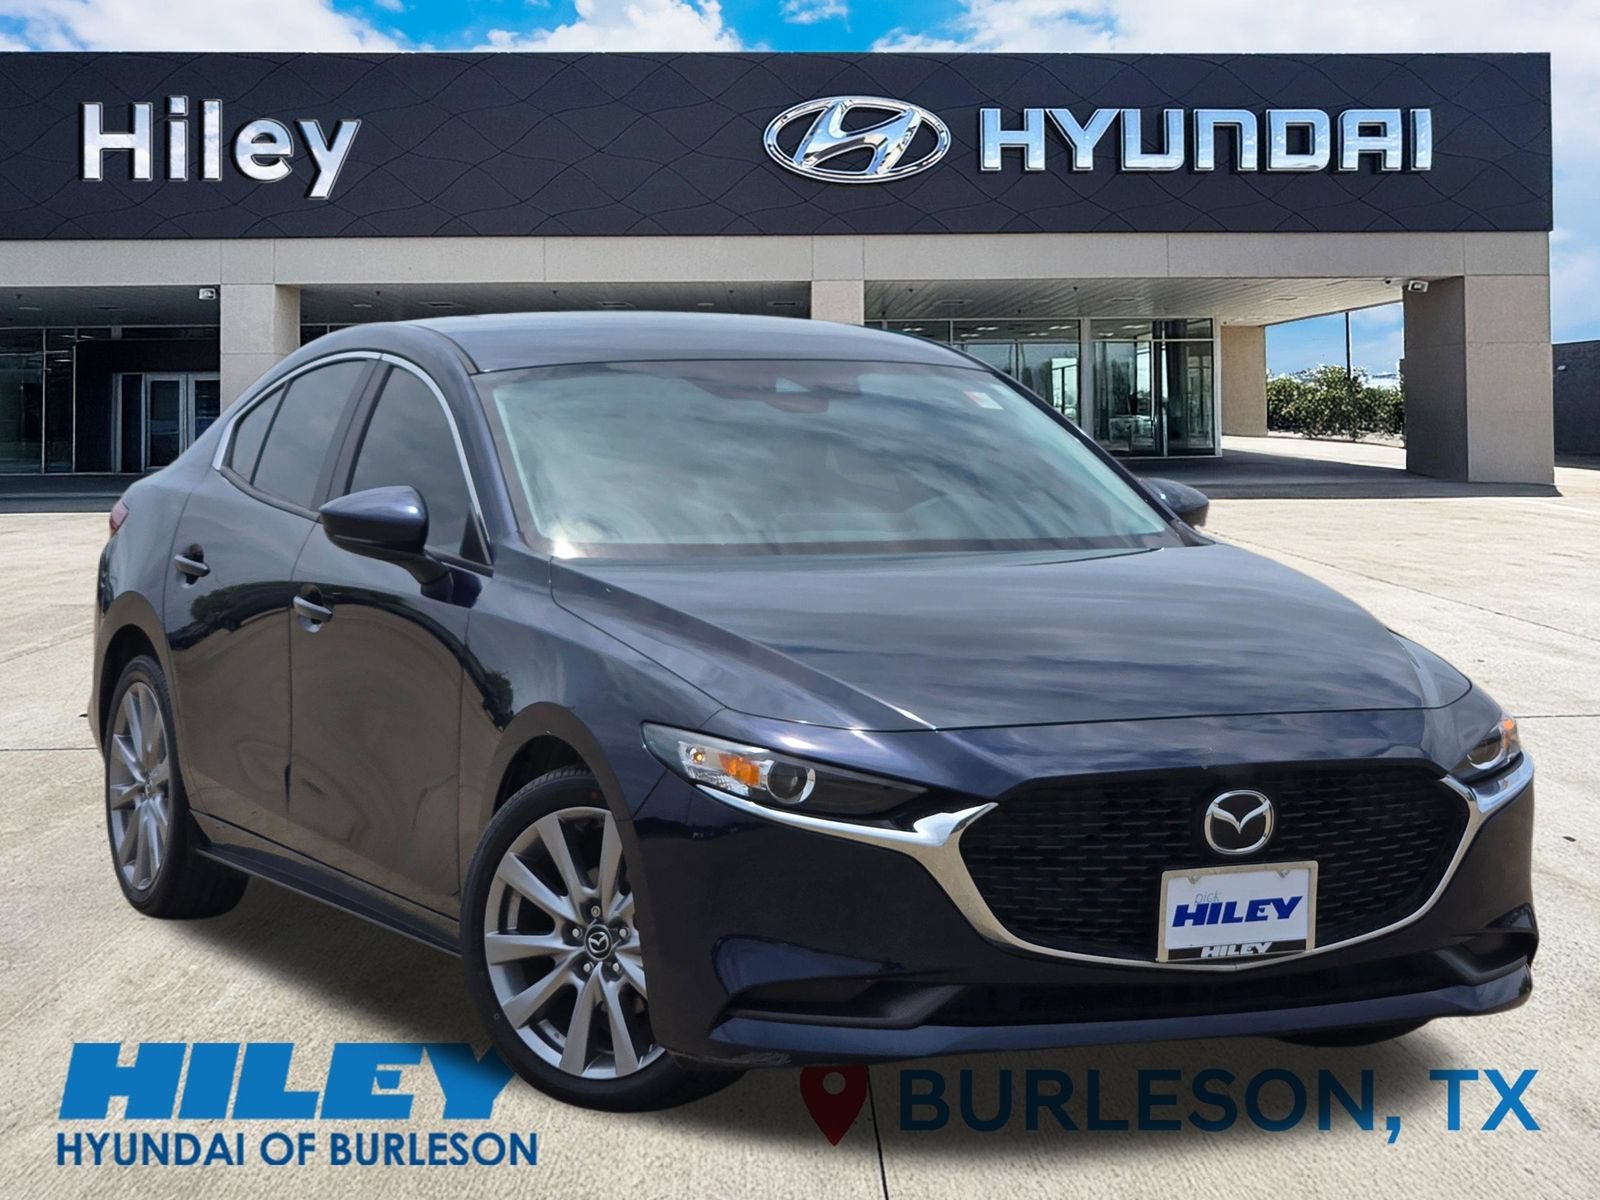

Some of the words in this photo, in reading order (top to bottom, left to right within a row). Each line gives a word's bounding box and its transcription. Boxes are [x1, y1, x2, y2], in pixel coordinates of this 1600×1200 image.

[80, 96, 361, 200] Hiley
[980, 108, 1433, 172] HYUNDAI
[1172, 896, 1303, 927] HILEY
[1200, 942, 1272, 958] HILEY
